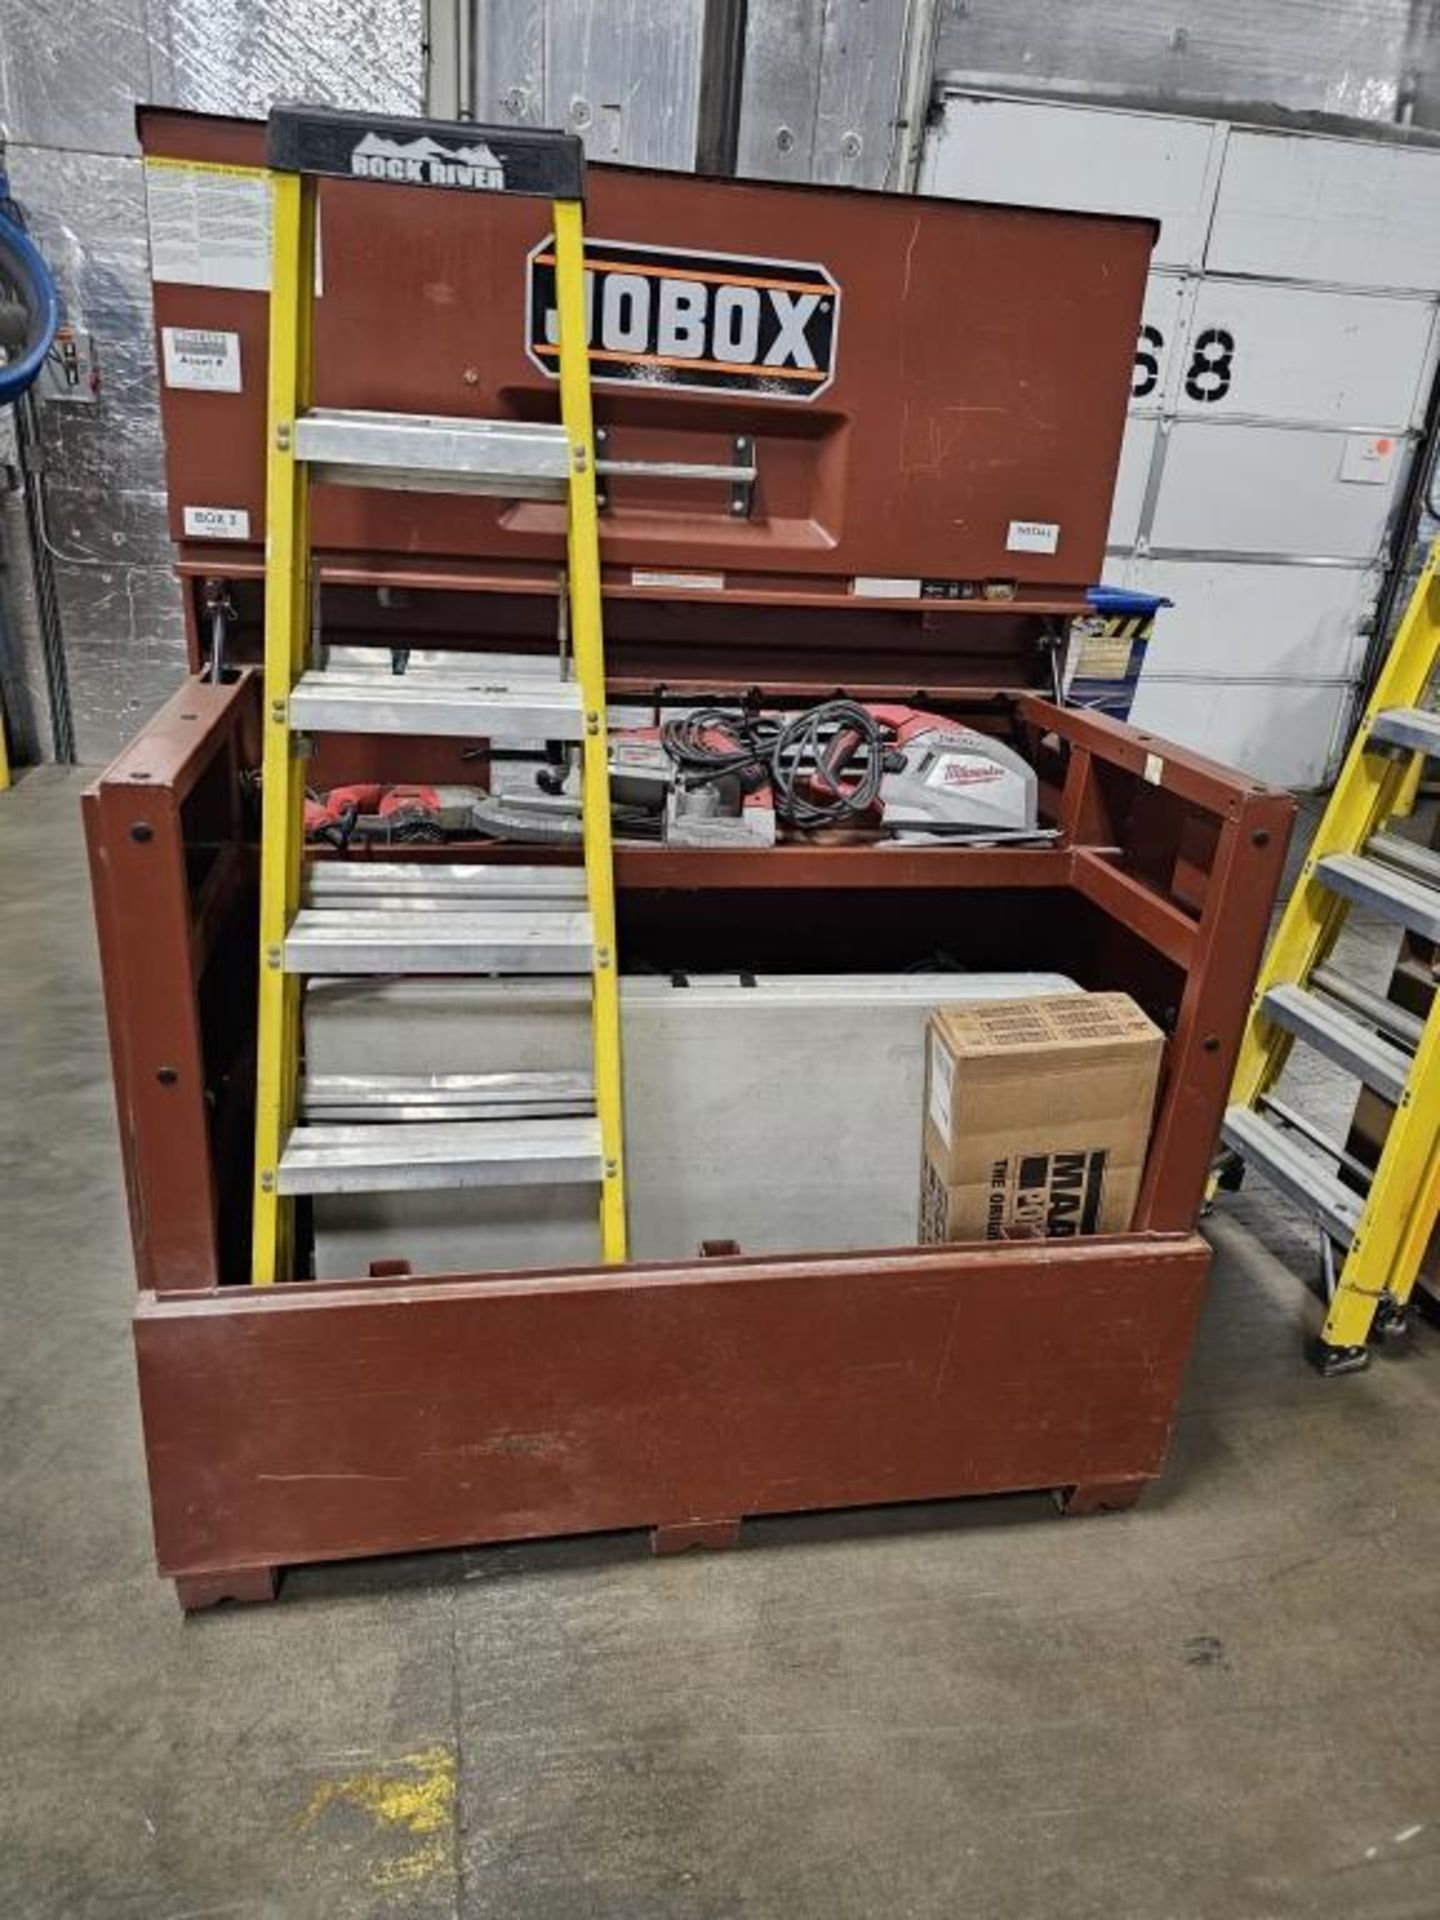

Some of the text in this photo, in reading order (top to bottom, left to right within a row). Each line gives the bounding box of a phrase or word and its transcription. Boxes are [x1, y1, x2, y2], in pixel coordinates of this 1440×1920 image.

[352, 153, 505, 191] ROCK RIVER
[991, 1158, 1008, 1189] THE
